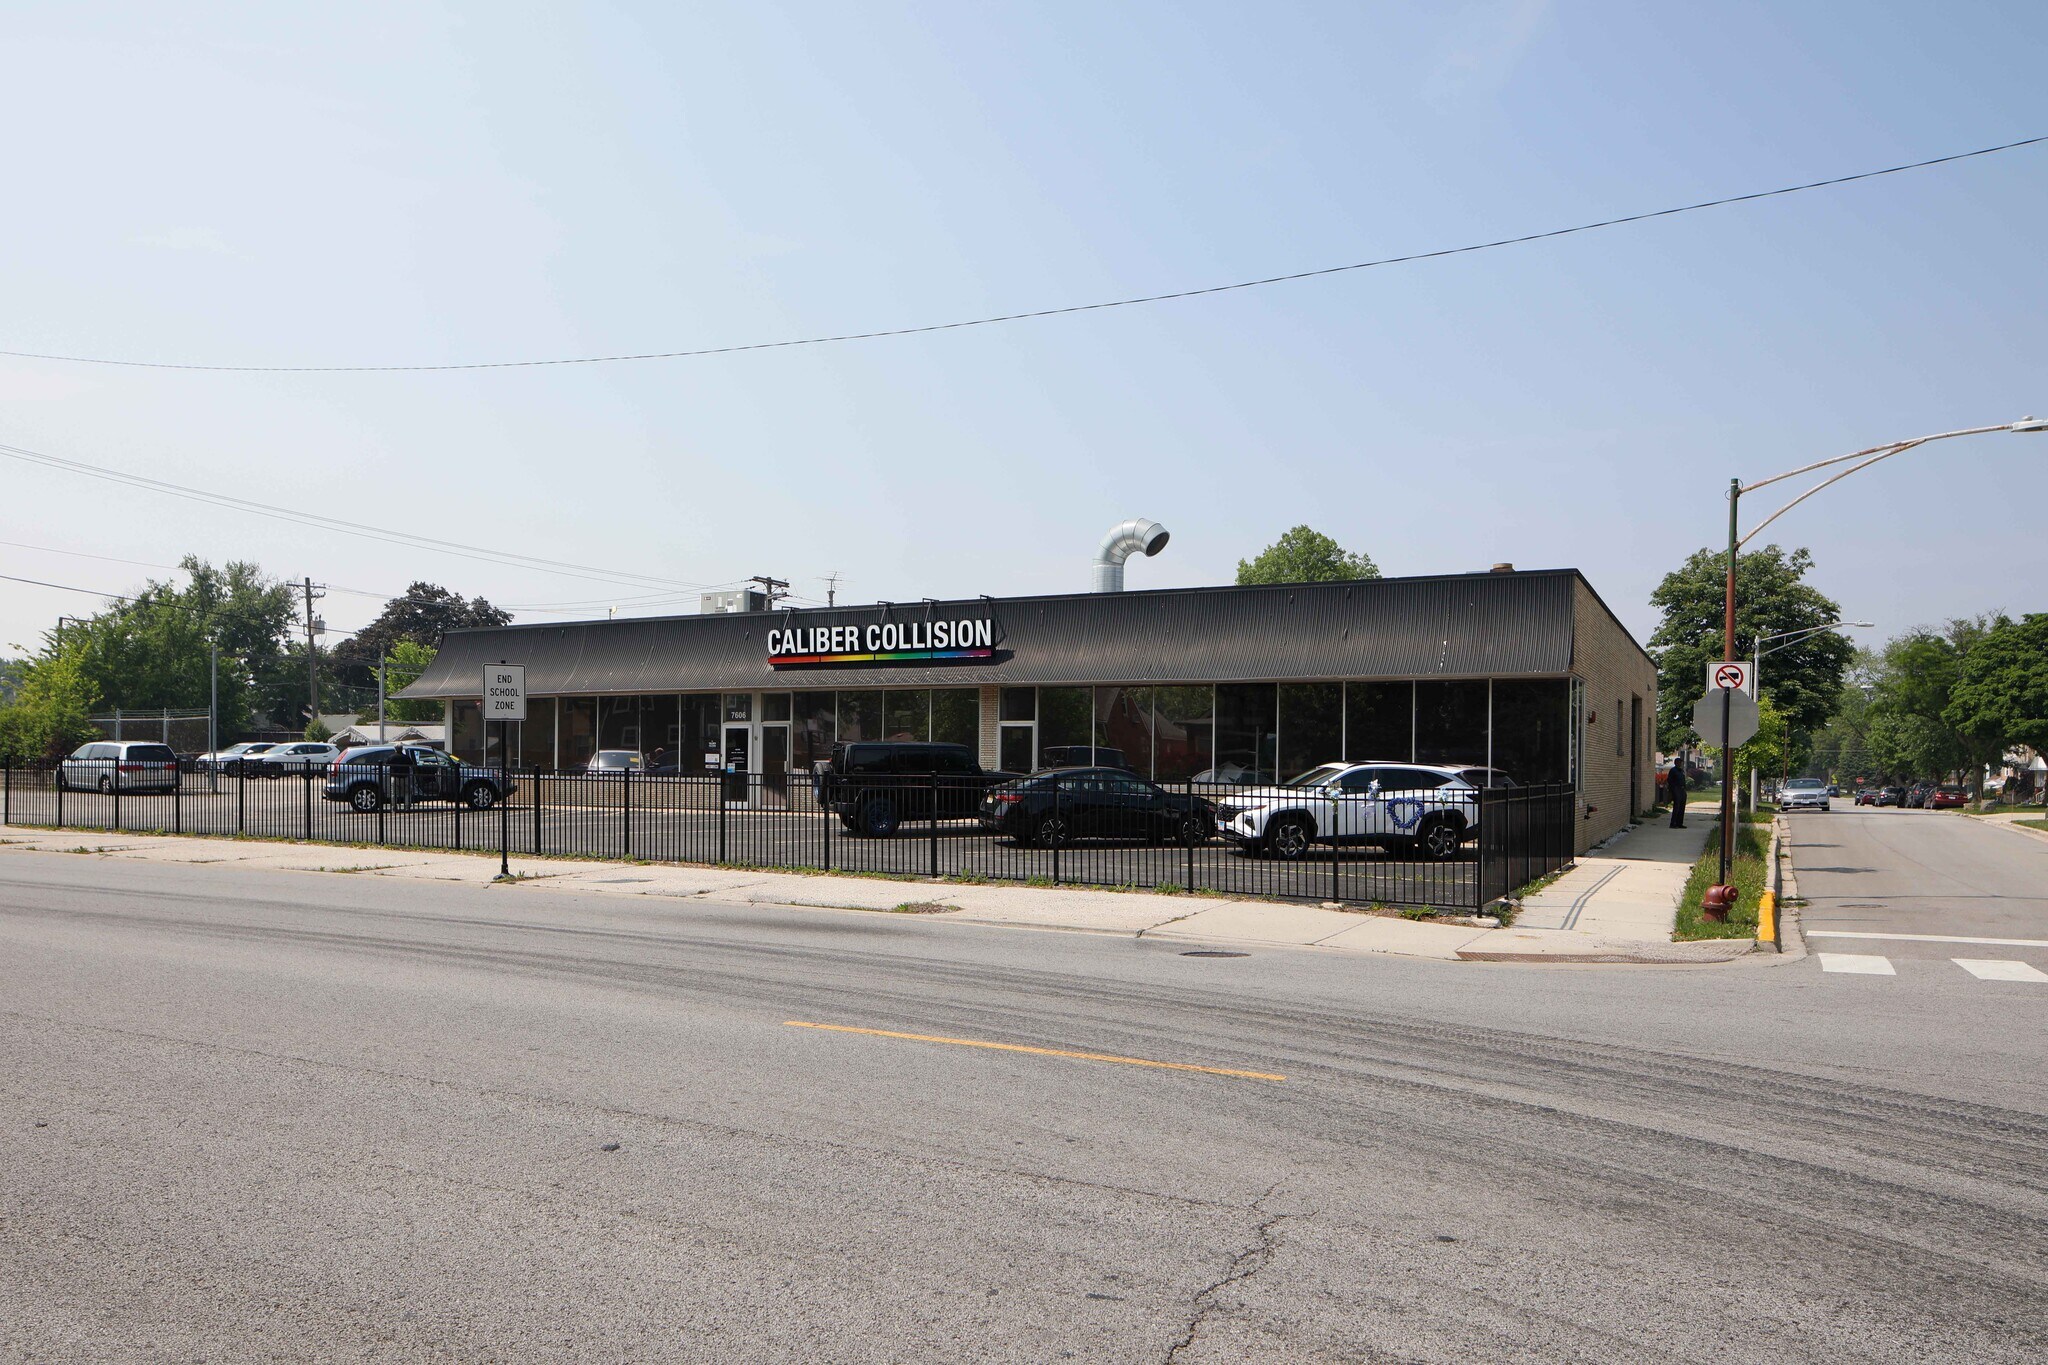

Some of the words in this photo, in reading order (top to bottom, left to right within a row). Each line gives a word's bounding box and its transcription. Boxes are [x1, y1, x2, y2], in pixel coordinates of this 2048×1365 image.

[767, 626, 860, 655] CALIBER
[866, 619, 992, 651] COLLISION
[497, 674, 513, 684] END
[490, 687, 520, 697] SCHOOL
[495, 700, 515, 710] ZONE
